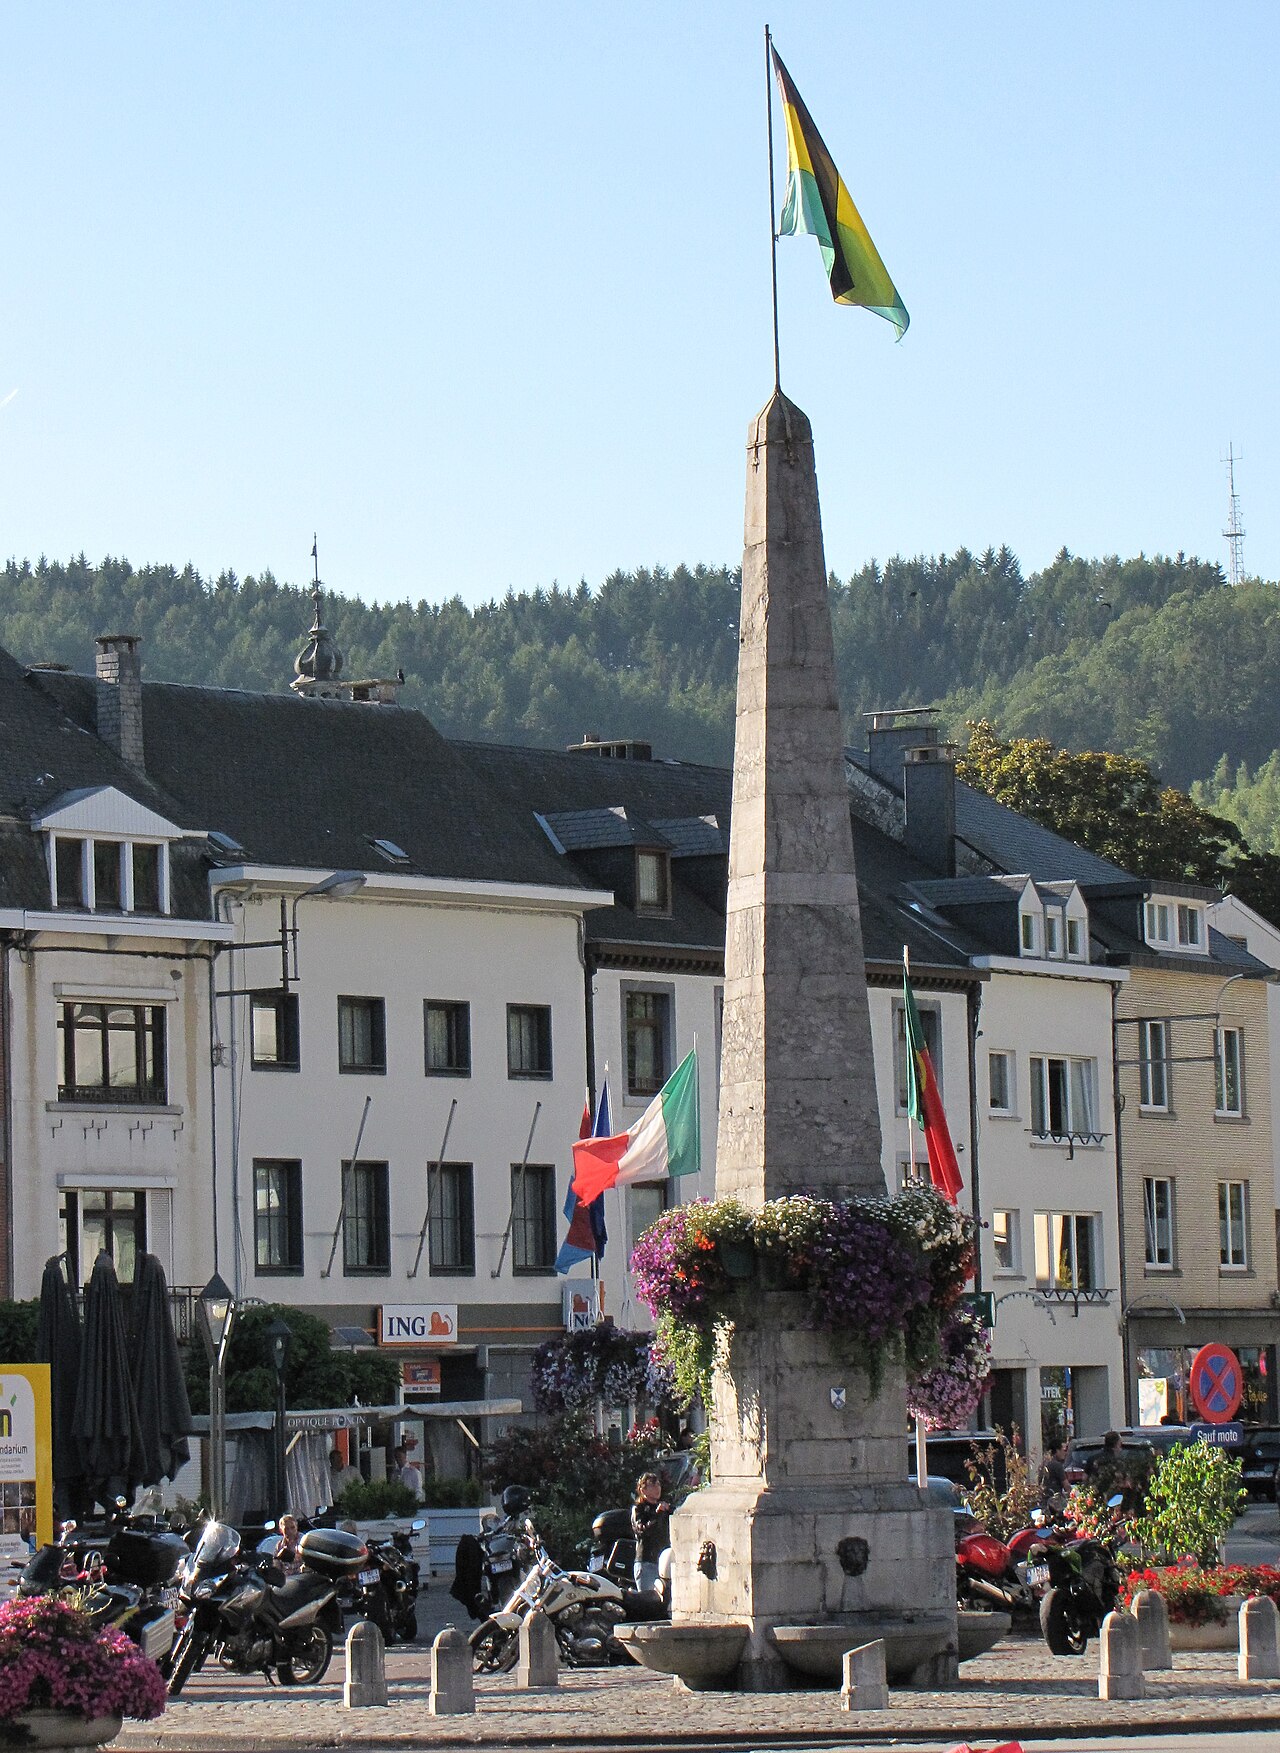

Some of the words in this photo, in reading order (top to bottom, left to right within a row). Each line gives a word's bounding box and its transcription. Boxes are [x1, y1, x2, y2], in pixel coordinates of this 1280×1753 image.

[387, 1316, 426, 1336] ING
[287, 1417, 327, 1428] OPTIQUE
[1197, 1429, 1216, 1442] Sauf
[1217, 1429, 1238, 1442] moto
